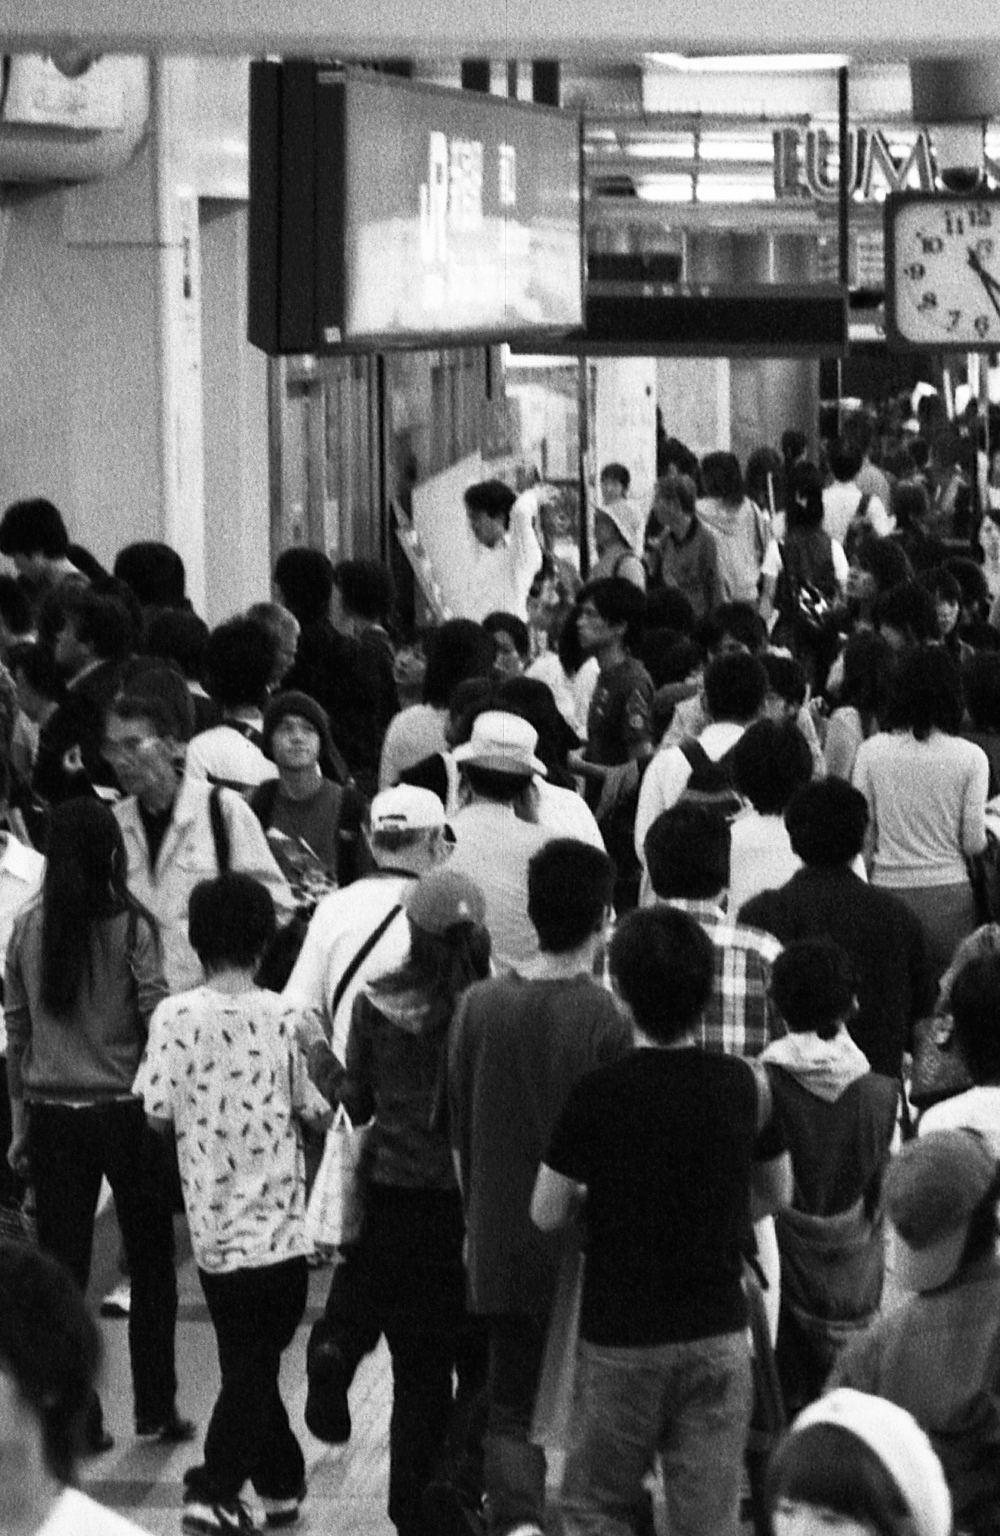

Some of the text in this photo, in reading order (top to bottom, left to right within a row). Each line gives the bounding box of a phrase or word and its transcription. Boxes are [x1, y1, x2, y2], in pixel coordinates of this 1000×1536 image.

[945, 213, 964, 235] 11
[968, 209, 993, 227] 12
[921, 237, 944, 254] 10
[909, 263, 926, 280] 9
[922, 292, 938, 308] 8
[948, 310, 962, 328] 7
[974, 315, 990, 333] 6
